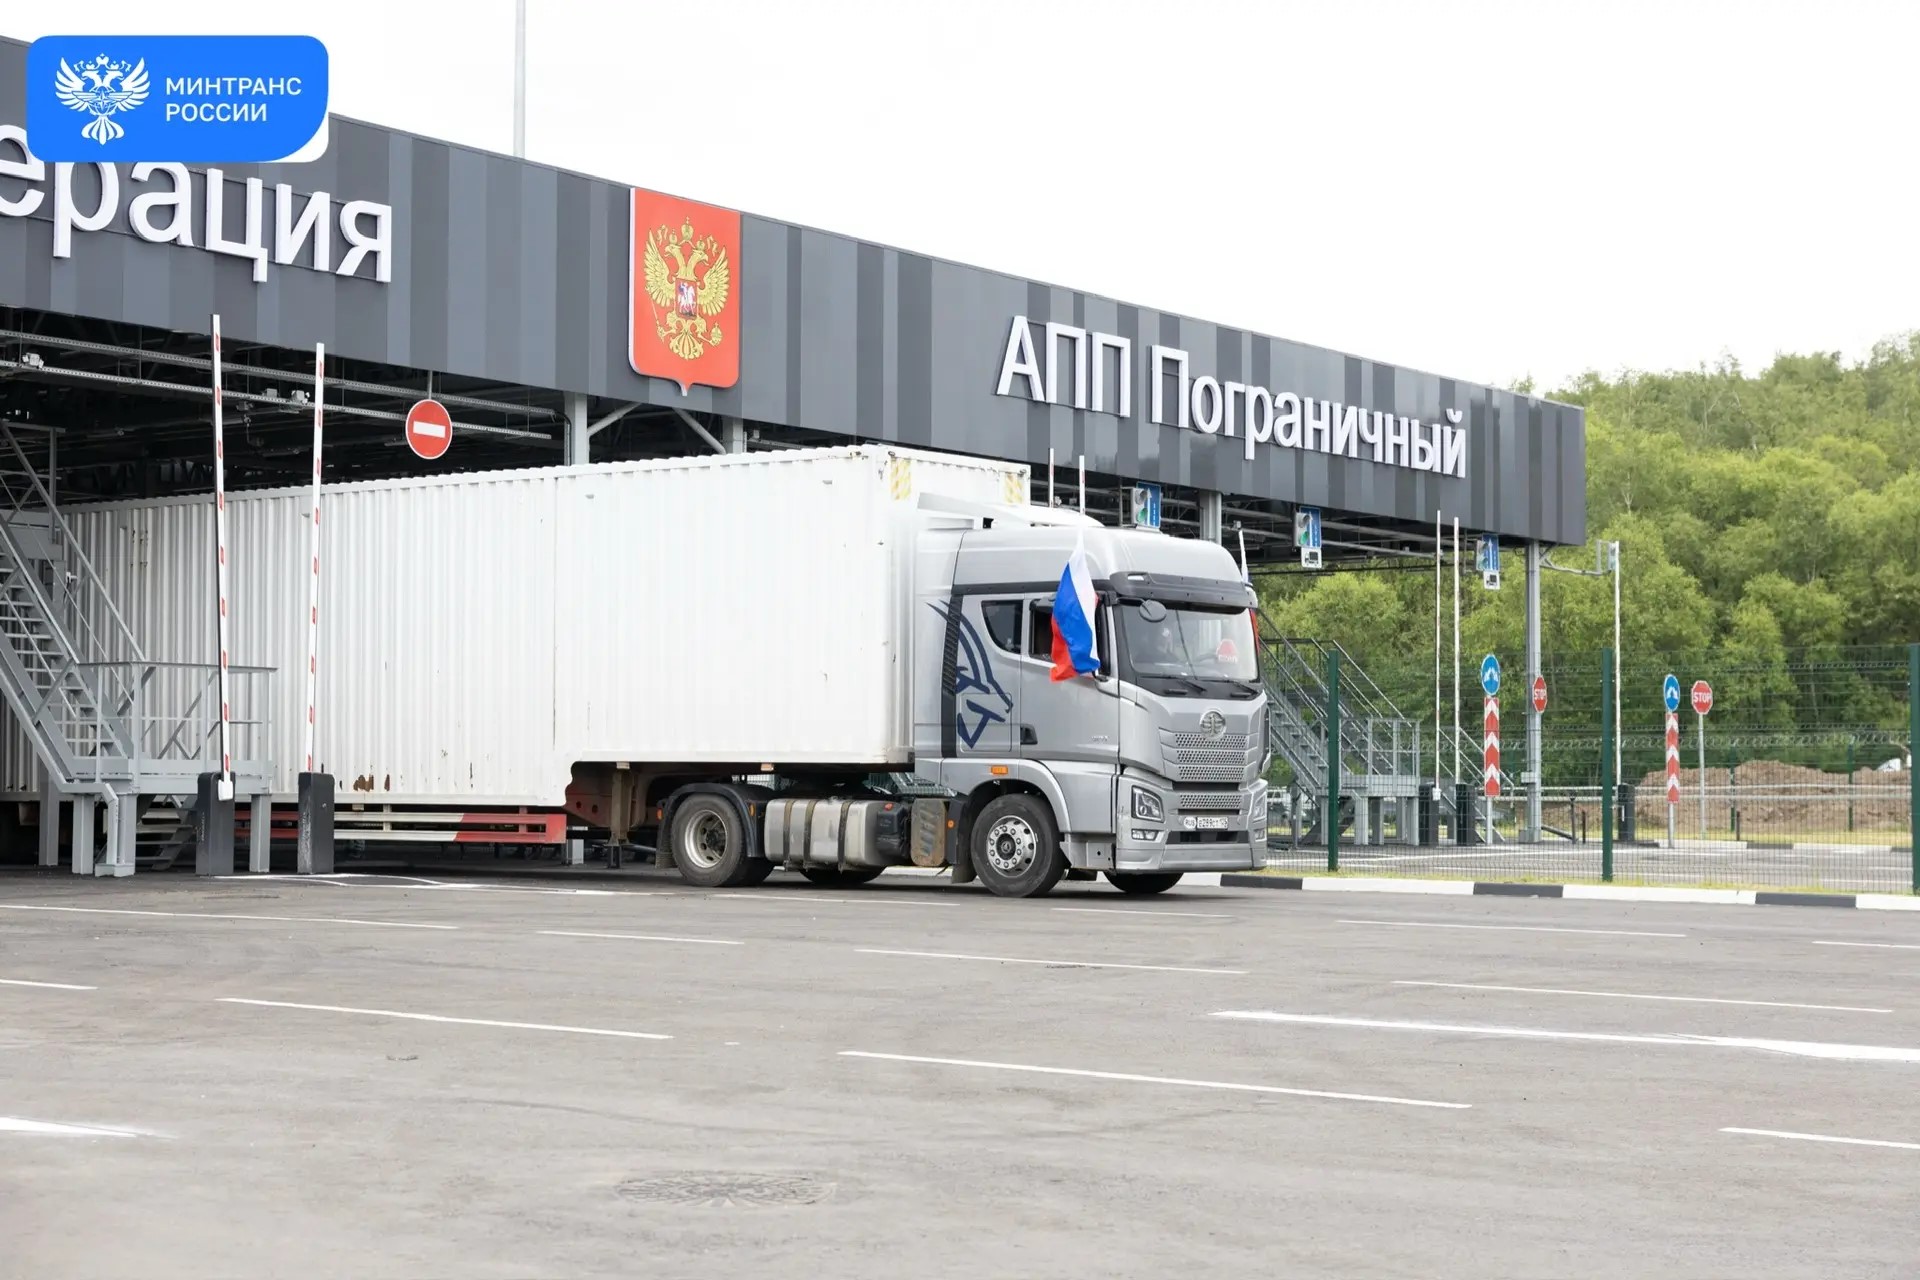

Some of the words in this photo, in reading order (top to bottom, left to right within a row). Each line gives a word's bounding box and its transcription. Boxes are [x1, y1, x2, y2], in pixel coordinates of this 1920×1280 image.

[996, 315, 1131, 418] АПП
[1150, 344, 1467, 478] Пограничный
[1693, 691, 1711, 703] STOP
